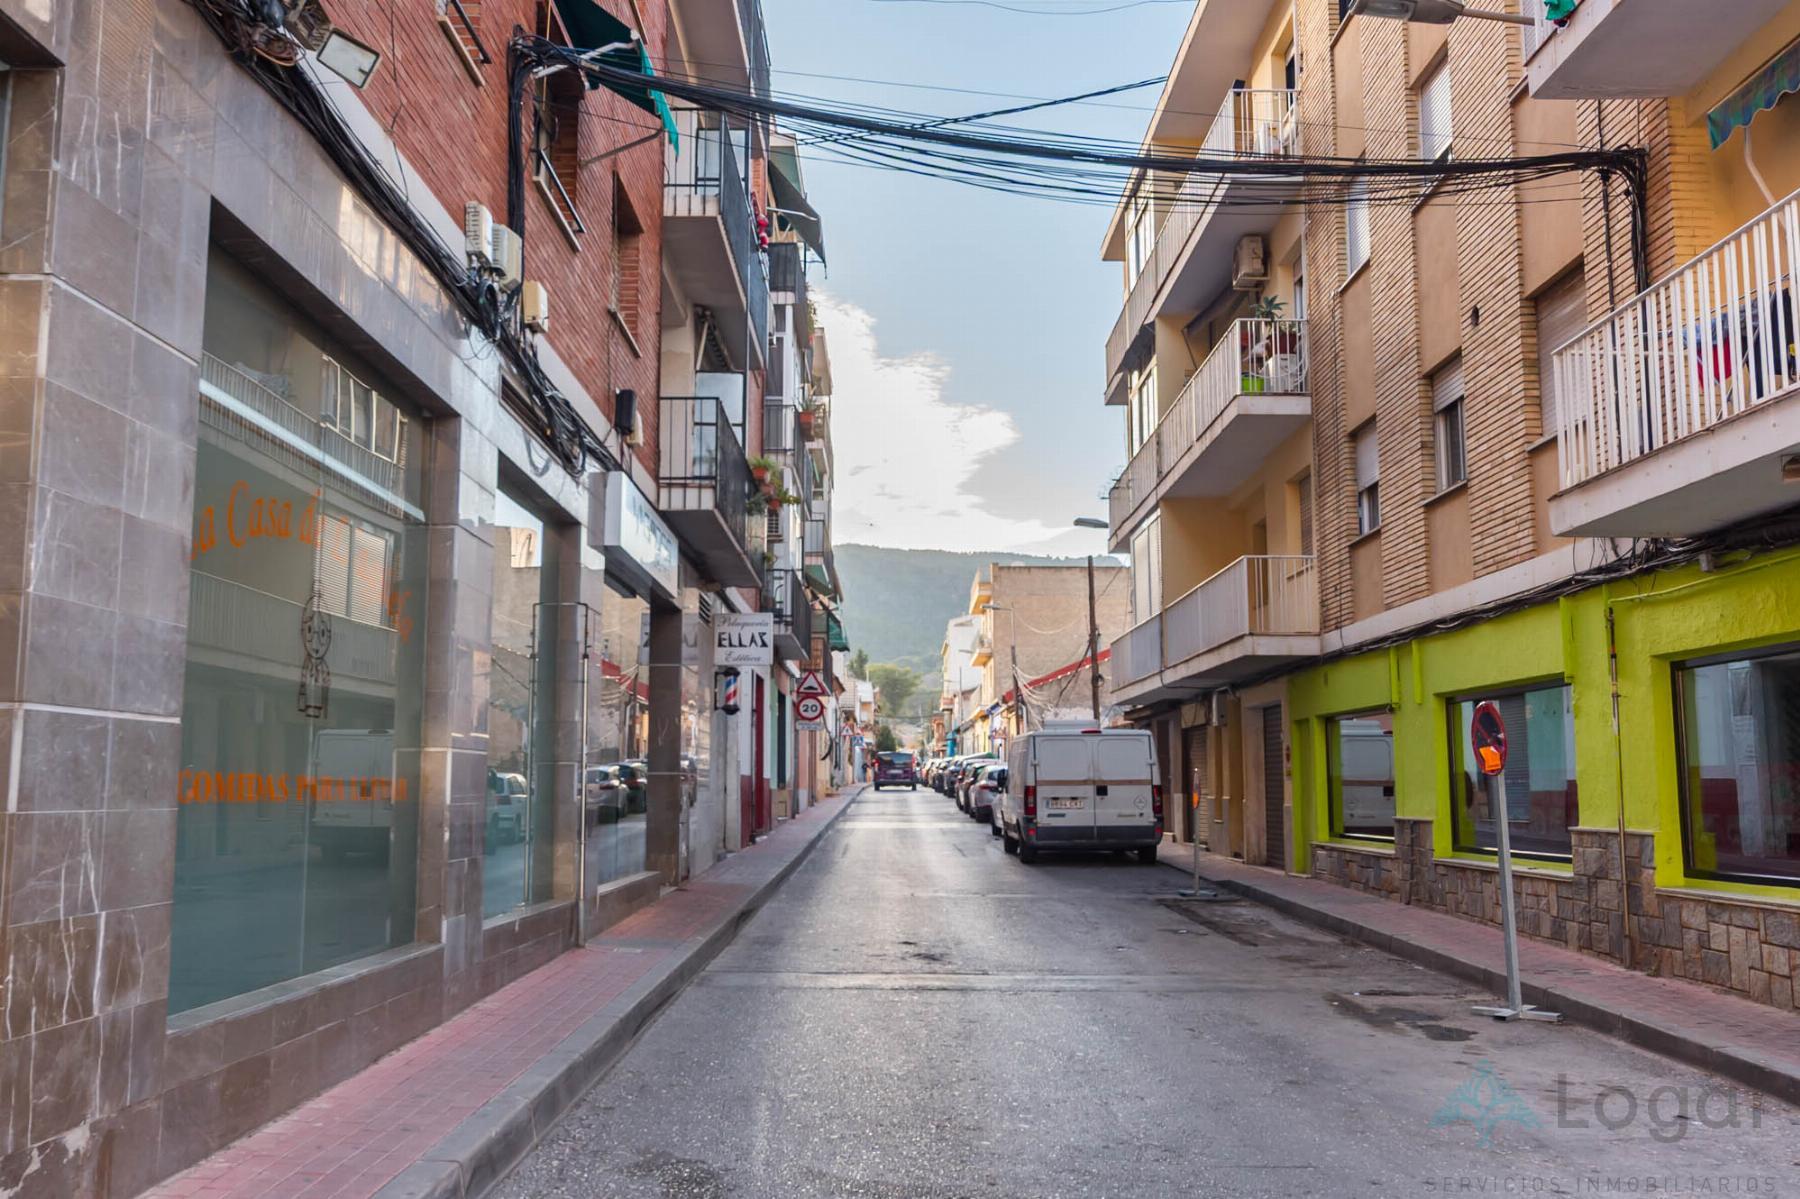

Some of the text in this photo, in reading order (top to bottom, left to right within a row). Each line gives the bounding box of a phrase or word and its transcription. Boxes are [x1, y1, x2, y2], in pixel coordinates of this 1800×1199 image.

[228, 480, 292, 548] Casa
[717, 631, 769, 648] ELLAS
[802, 704, 818, 713] 20
[177, 768, 289, 805] COMIDAS
